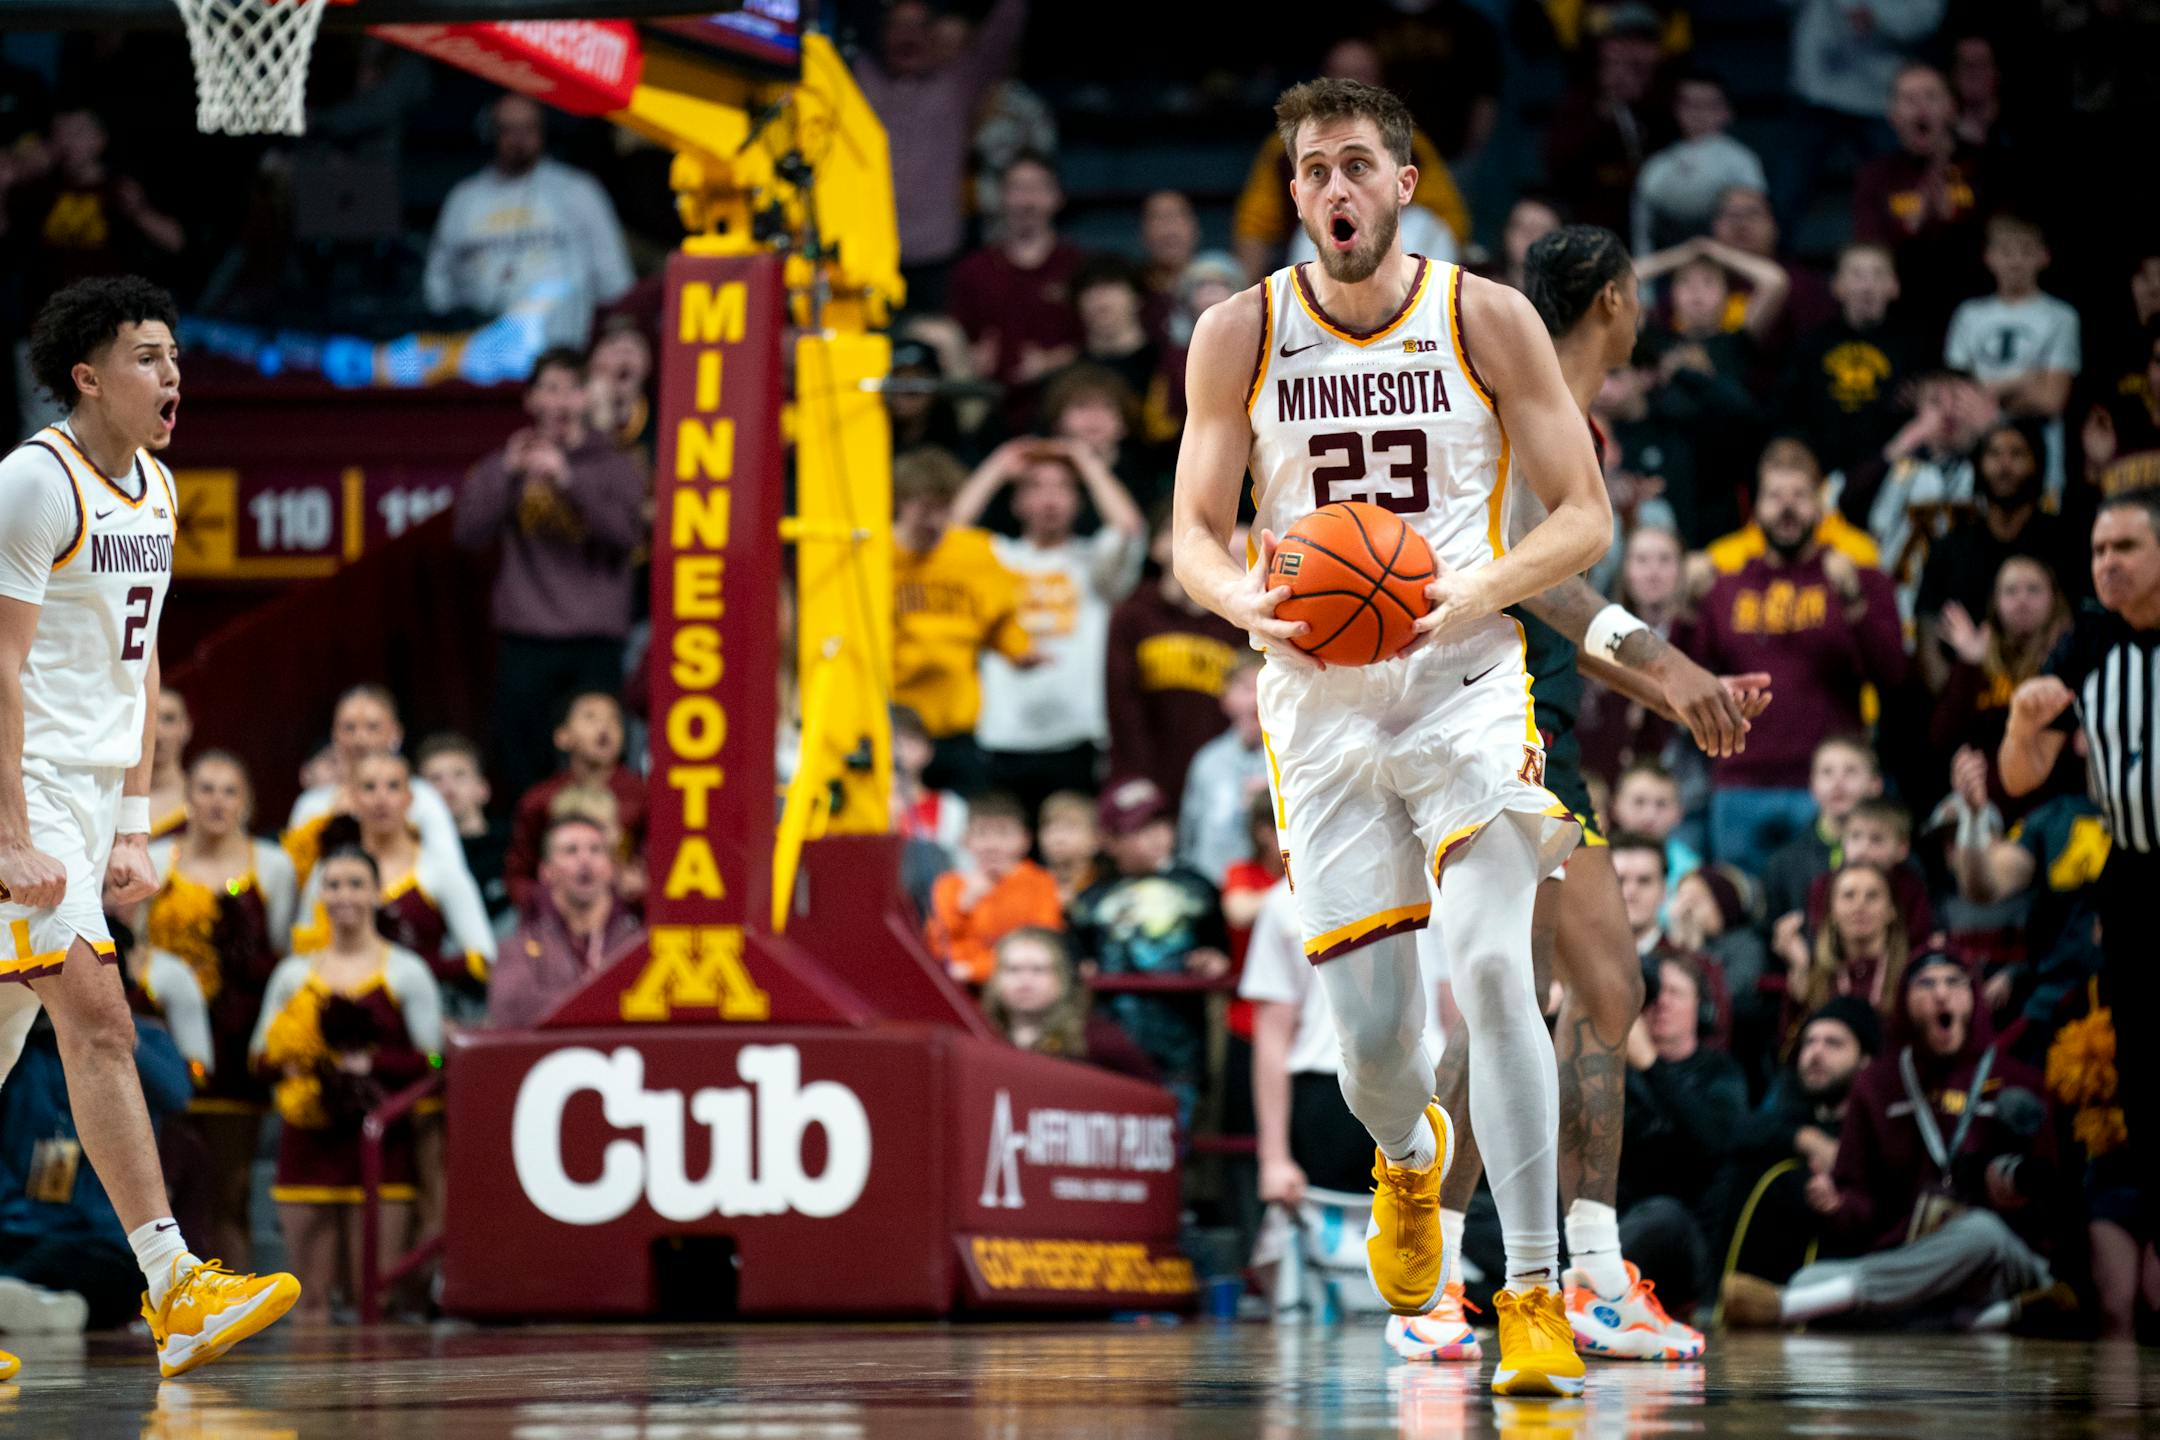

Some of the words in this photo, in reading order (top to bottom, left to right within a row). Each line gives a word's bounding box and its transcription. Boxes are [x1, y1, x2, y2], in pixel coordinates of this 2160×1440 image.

[1277, 369, 1451, 422] MINNESOTA
[1308, 428, 1429, 514] 23
[91, 534, 173, 573] MINNESOT
[249, 487, 332, 550] 110
[121, 586, 153, 660] 2
[664, 281, 748, 900] MINNESOTA
[620, 925, 770, 1021] M
[512, 1044, 872, 1225] Cub
